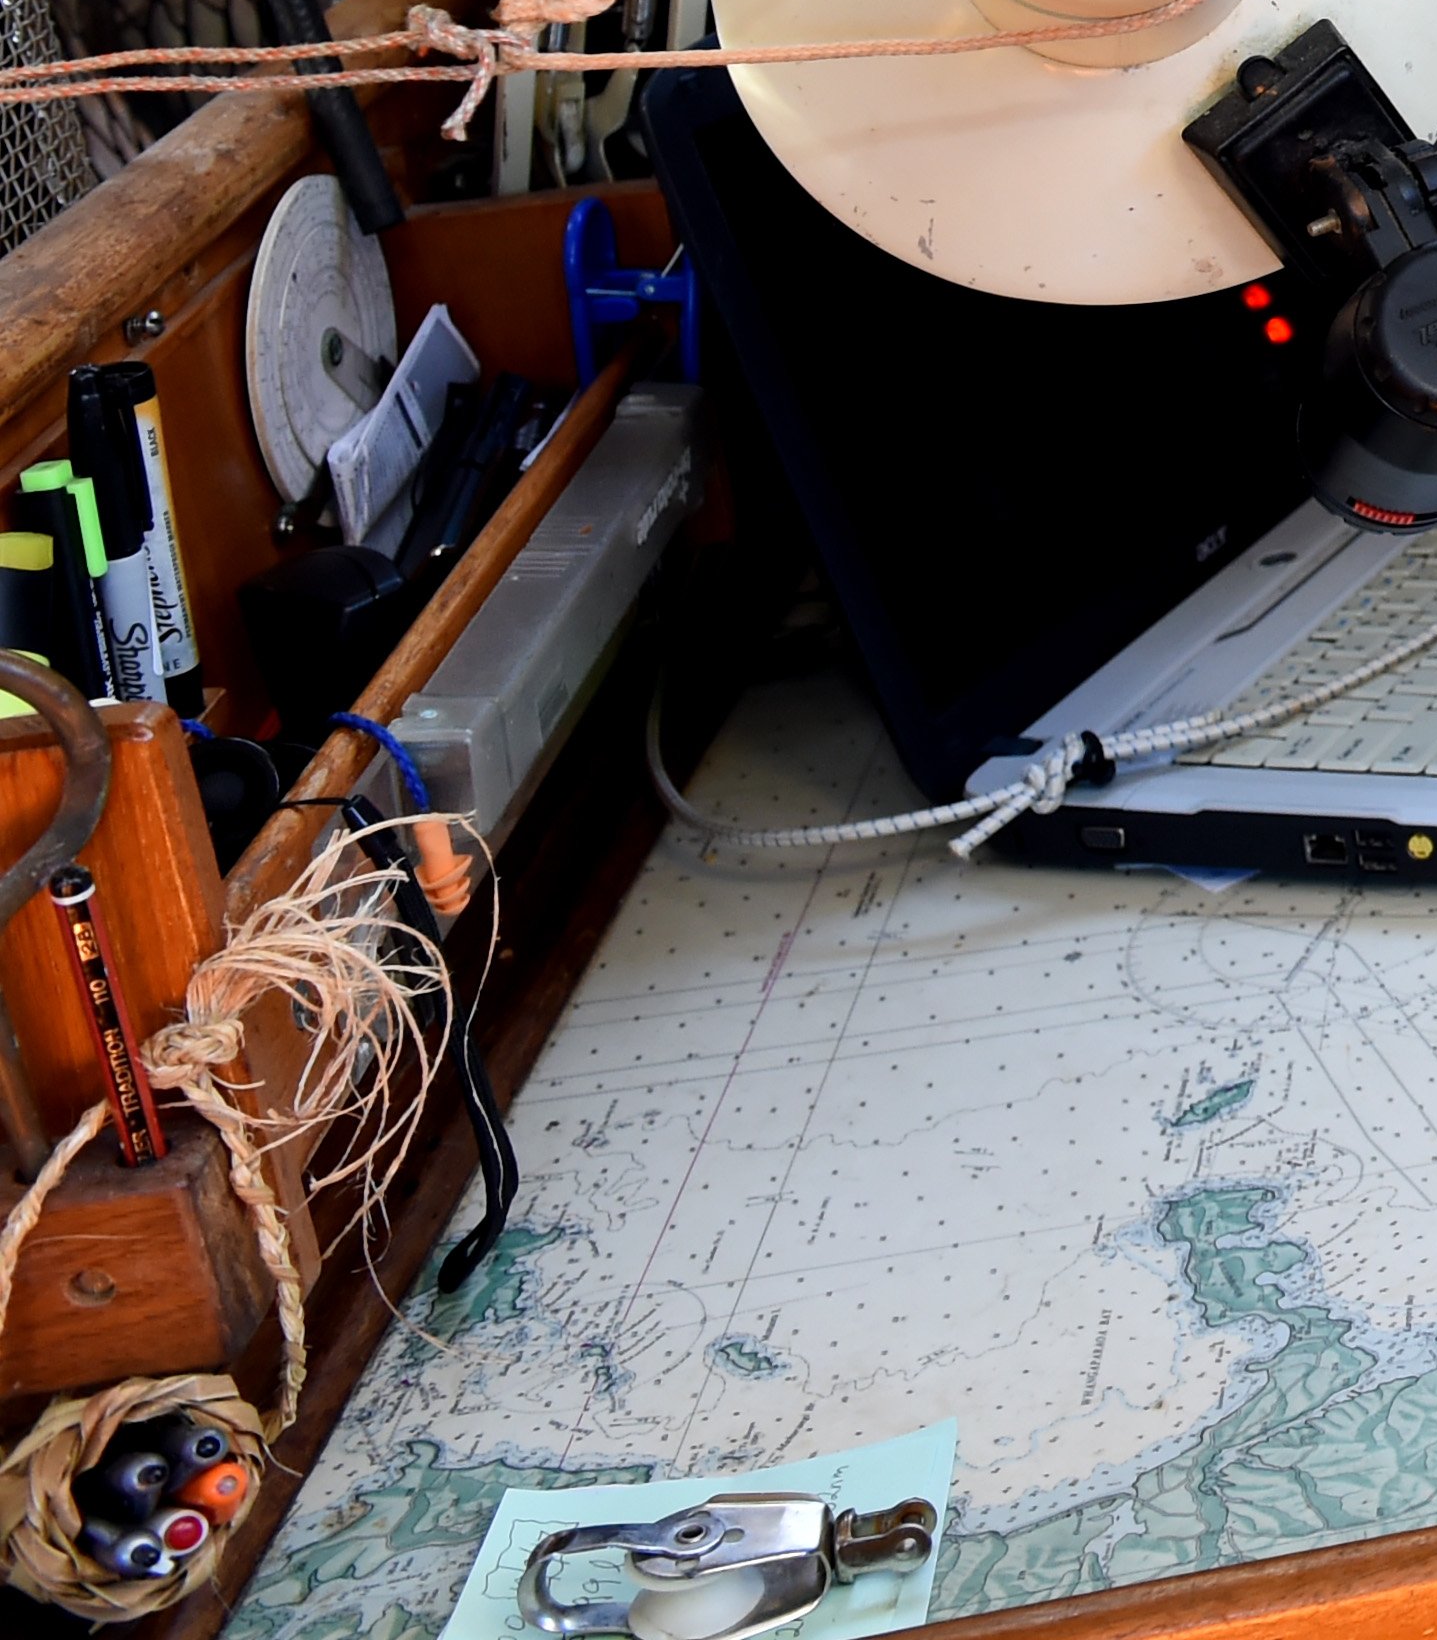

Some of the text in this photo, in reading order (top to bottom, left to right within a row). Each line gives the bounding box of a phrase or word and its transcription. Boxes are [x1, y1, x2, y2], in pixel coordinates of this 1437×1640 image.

[146, 427, 158, 457] BLACK
[109, 617, 154, 704] Sharpi
[76, 929, 99, 958] 2B
[89, 978, 110, 1006] 110
[103, 1028, 141, 1118] TRADITION
